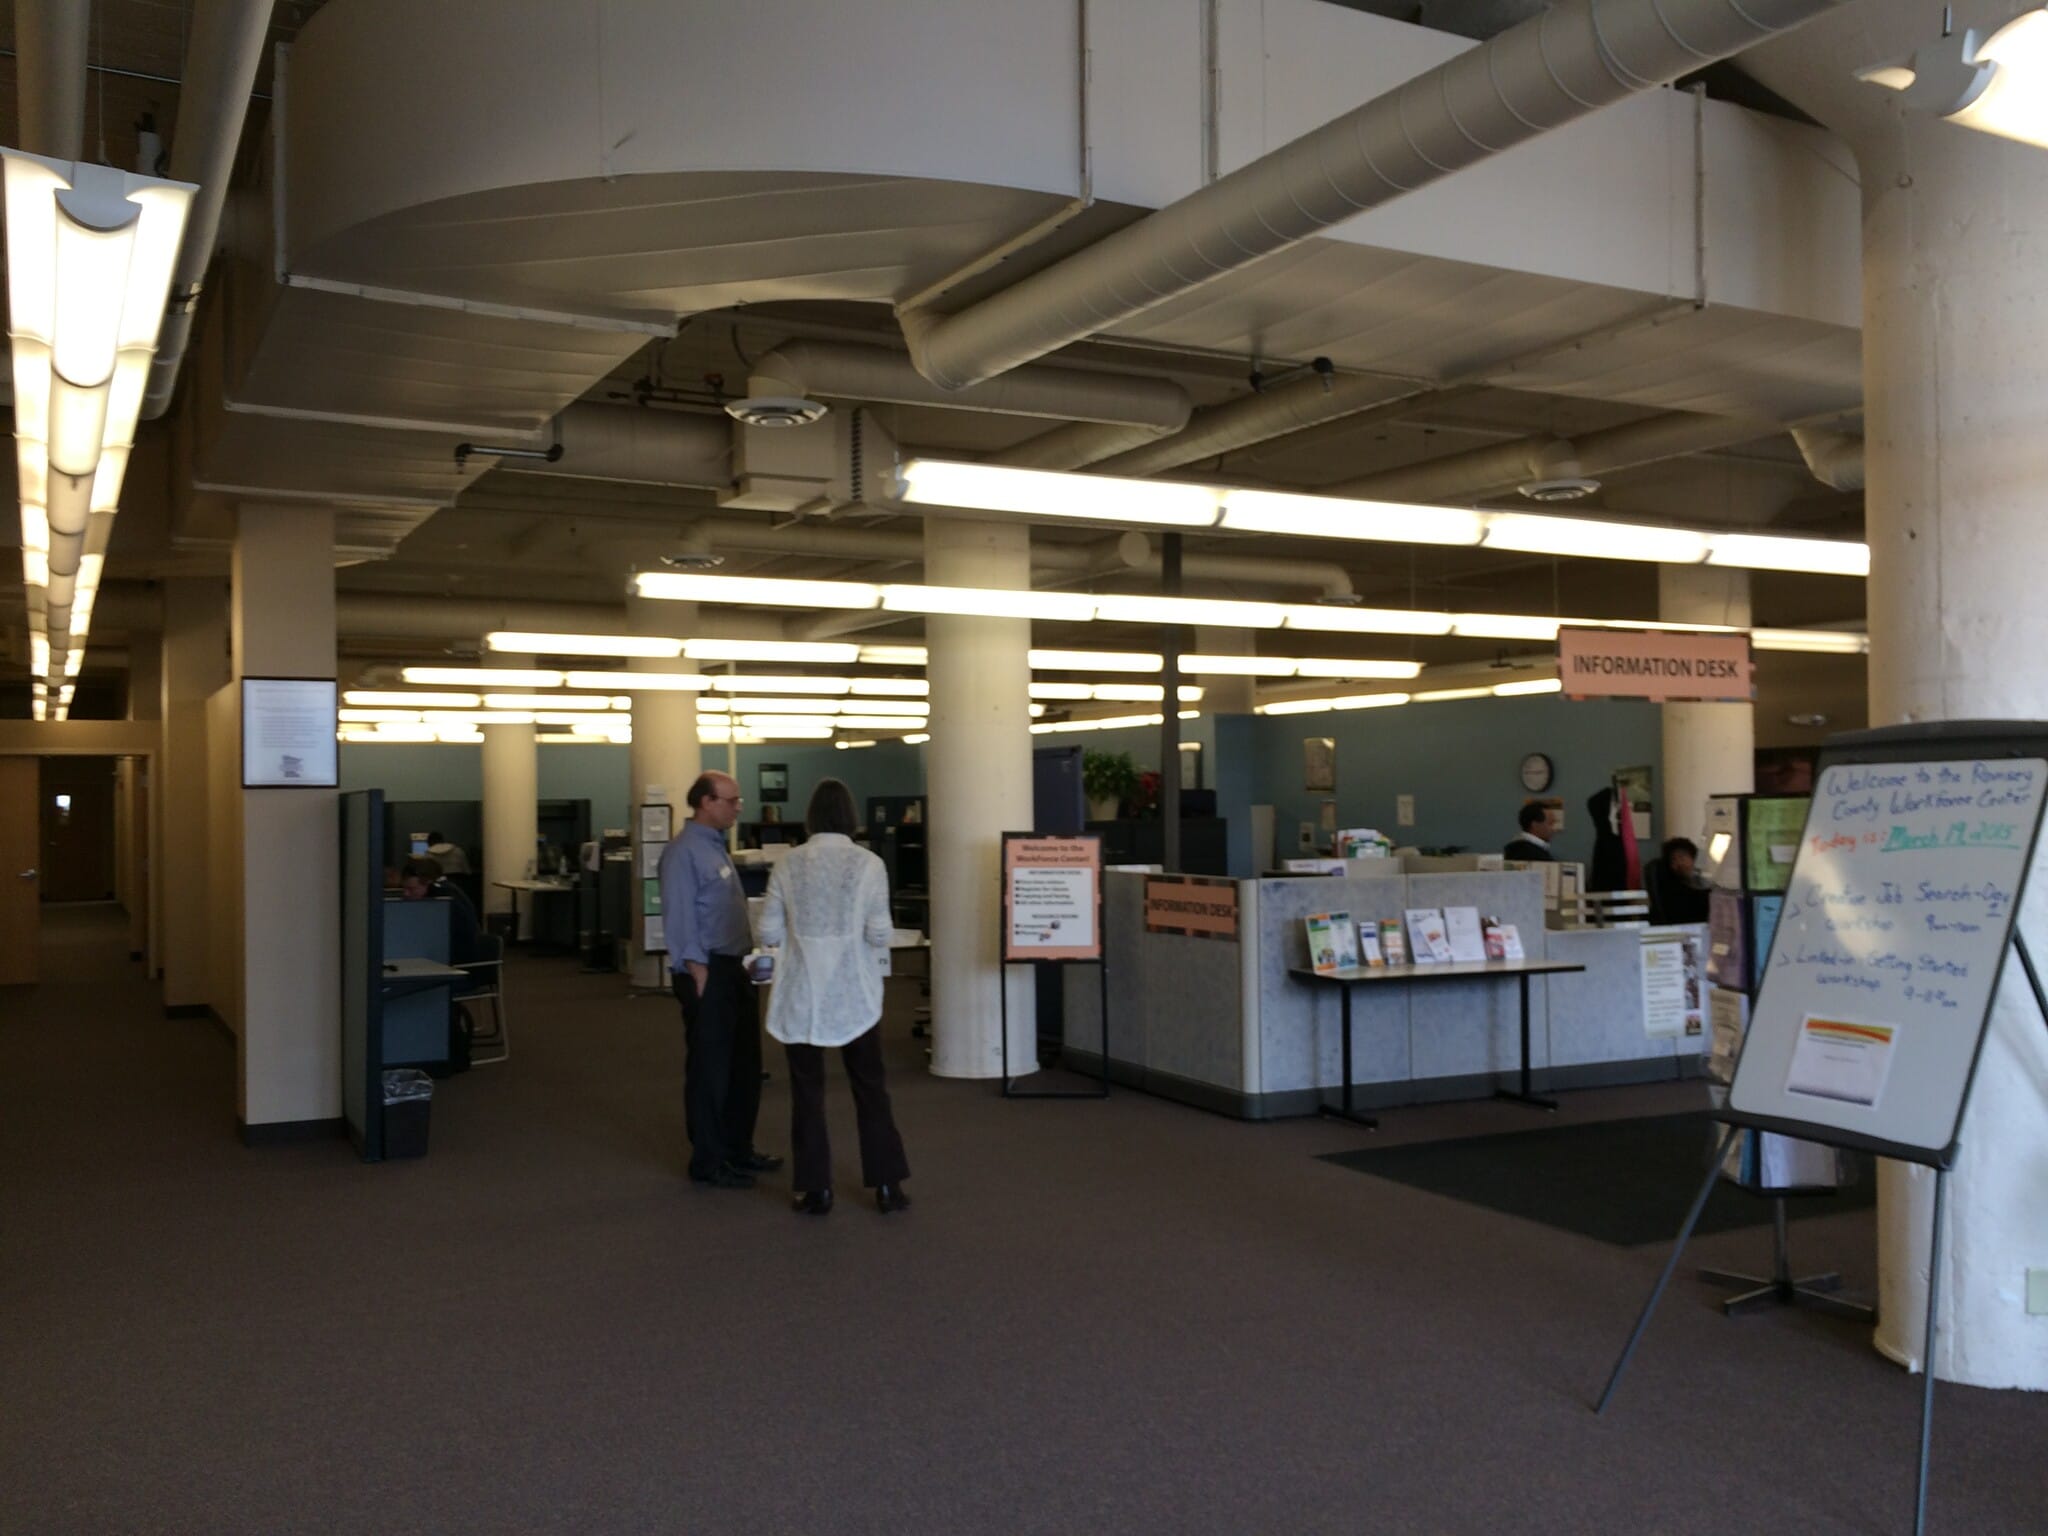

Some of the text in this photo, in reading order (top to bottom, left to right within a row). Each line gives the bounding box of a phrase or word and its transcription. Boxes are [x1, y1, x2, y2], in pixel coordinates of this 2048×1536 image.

[1574, 654, 1739, 680] INFORMATION DESK
[1826, 760, 2035, 797] Welcome to the Ramsey
[1831, 796, 1879, 822] County
[1976, 788, 2031, 809] Center
[1022, 844, 1058, 852] Welcome
[1070, 844, 1084, 852] the
[1811, 832, 1857, 857] Today
[1884, 825, 1940, 850] March
[1149, 897, 1233, 918] INFORMATION DESK
